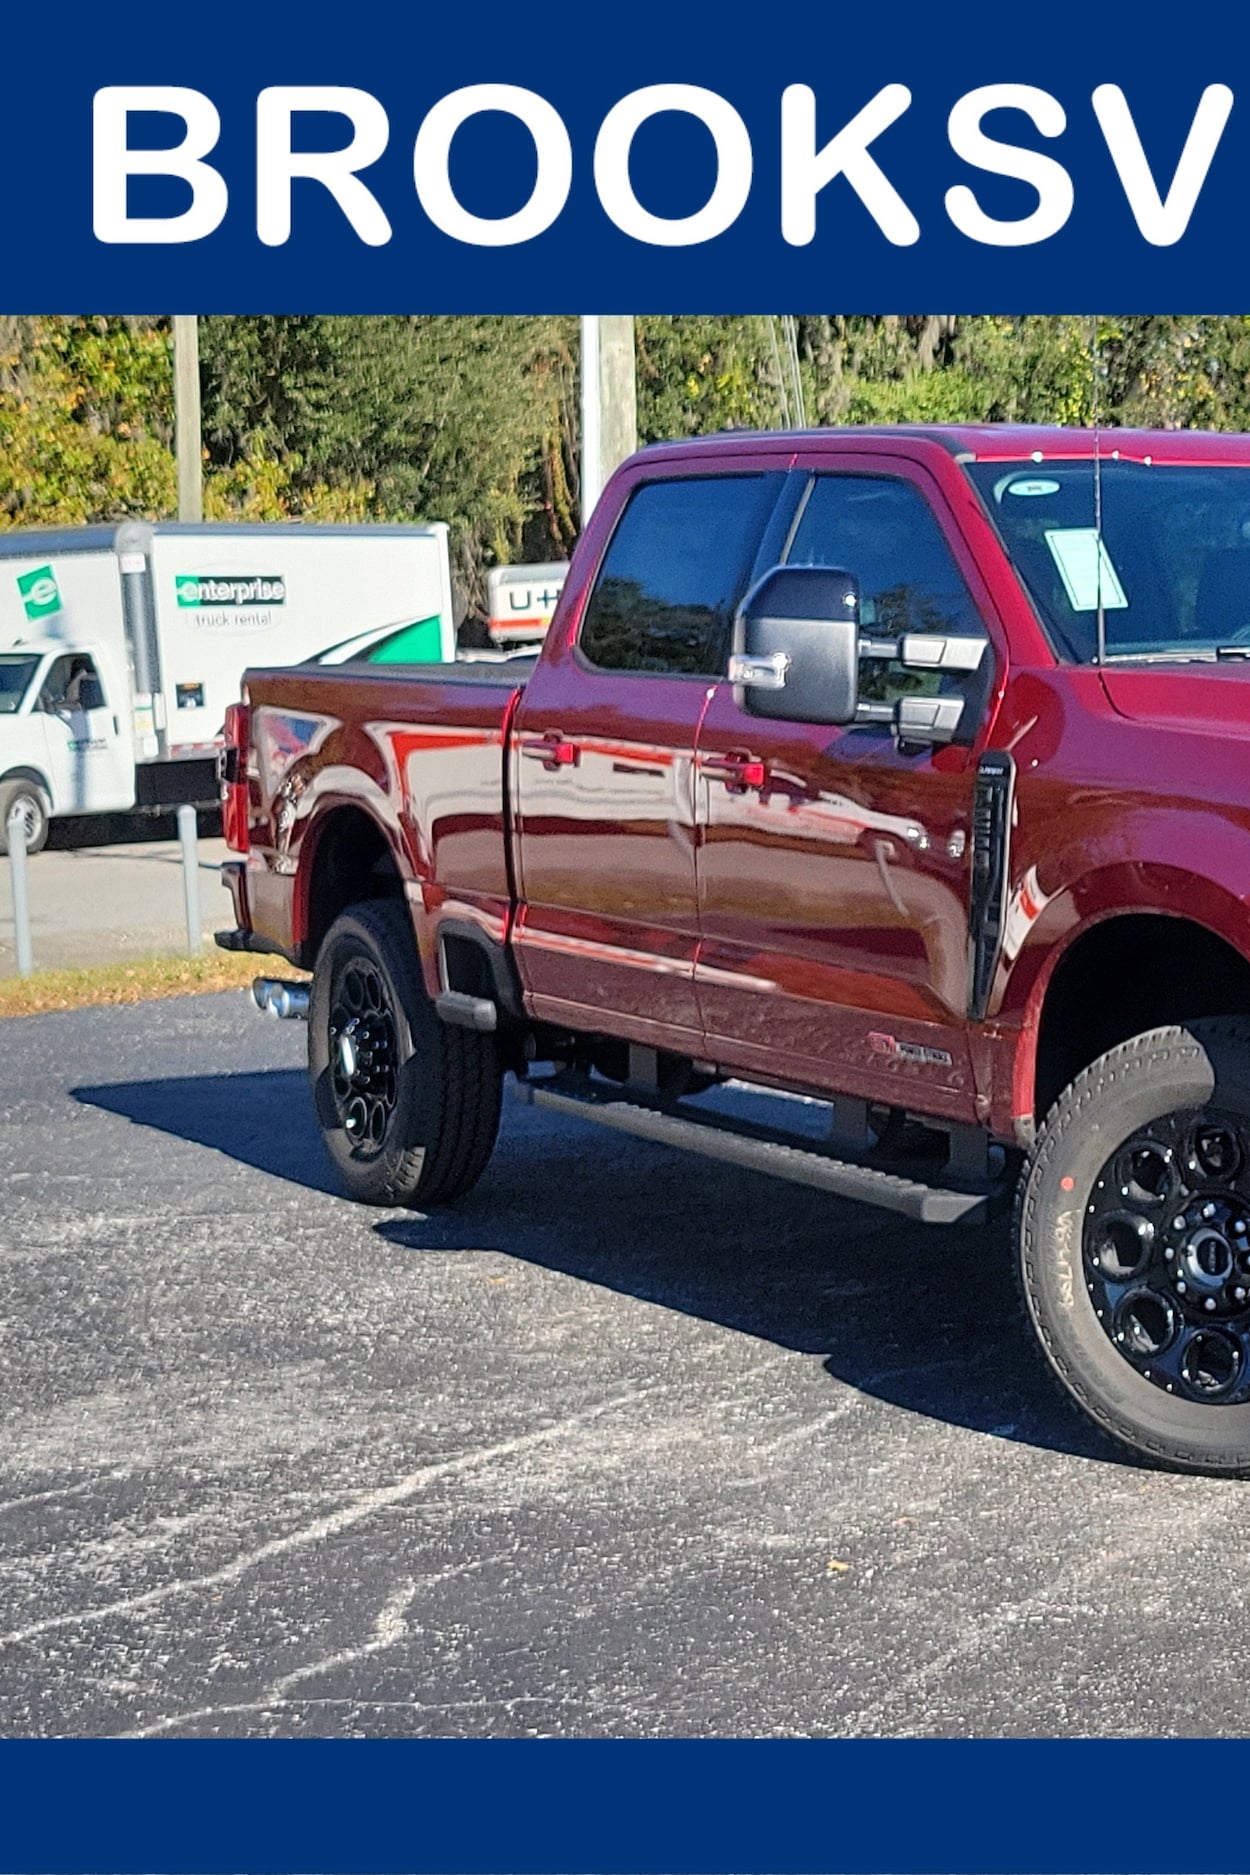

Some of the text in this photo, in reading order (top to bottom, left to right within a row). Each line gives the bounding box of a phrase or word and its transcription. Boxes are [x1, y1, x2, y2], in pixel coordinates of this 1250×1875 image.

[180, 577, 285, 604] enterprise
[196, 610, 272, 626] truck rental
